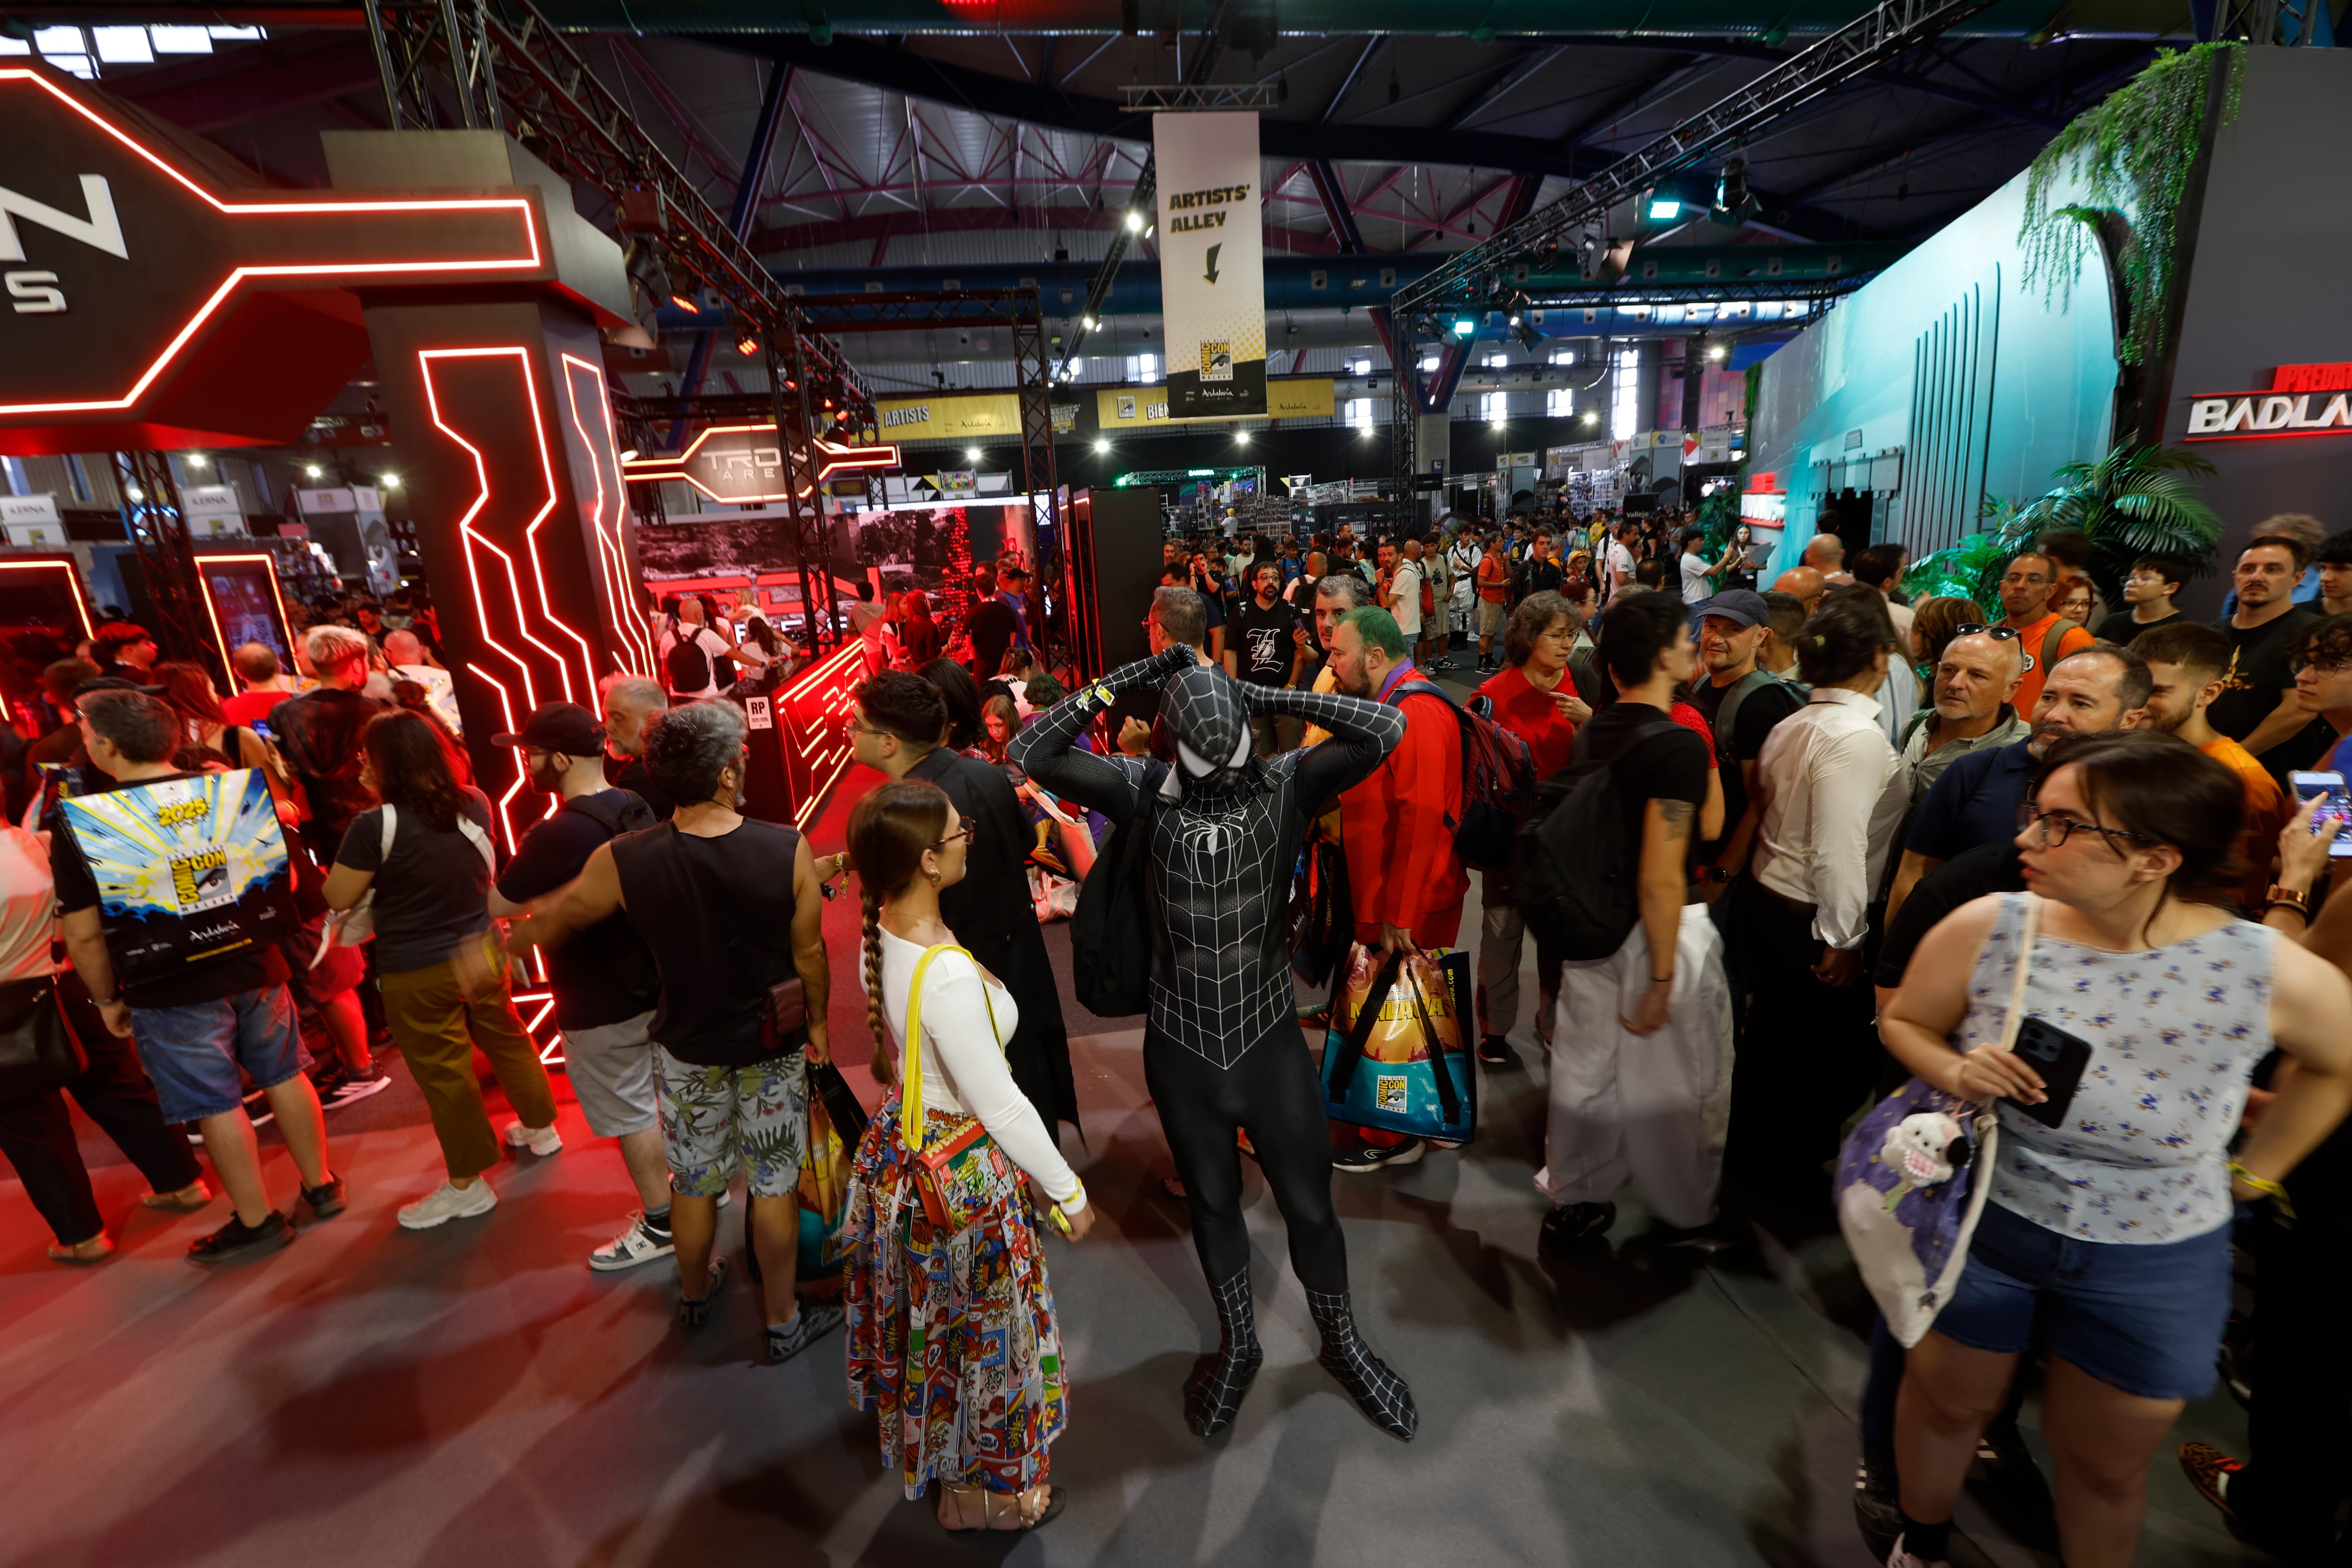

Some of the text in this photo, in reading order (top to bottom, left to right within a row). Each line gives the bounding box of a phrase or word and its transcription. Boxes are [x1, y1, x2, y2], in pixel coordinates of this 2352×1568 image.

[1169, 183, 1250, 210] ARTISTS'
[1170, 210, 1227, 234] ALLEY
[1200, 344, 1212, 374] COMIC
[1211, 343, 1230, 353] CON
[884, 405, 930, 427] ARTISTS
[2187, 394, 2352, 434] BADLA
[750, 701, 765, 715] RP
[158, 797, 208, 827] 2025
[191, 850, 227, 871] CON
[171, 859, 200, 905] COMIC
[1378, 1080, 1389, 1106] COMIC
[1388, 1081, 1405, 1090] CON
